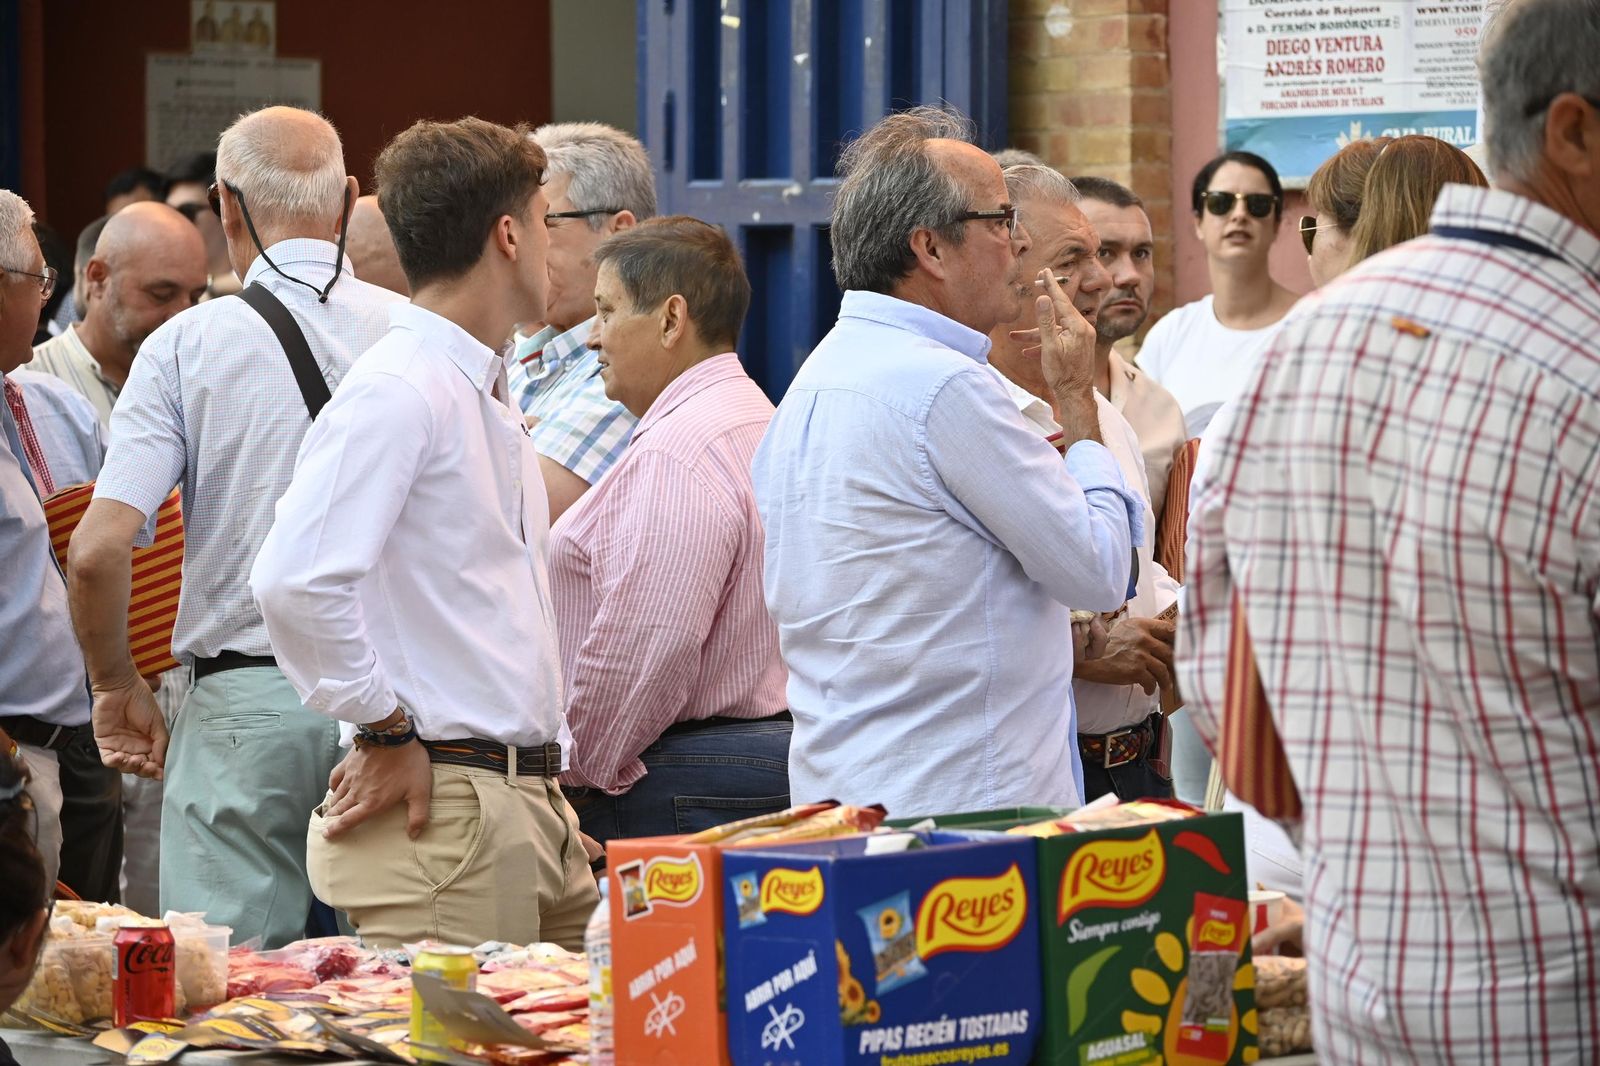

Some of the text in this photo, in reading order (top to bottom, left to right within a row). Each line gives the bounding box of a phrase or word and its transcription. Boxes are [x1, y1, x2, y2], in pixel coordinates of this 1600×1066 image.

[1264, 6, 1381, 18] Corrida de Rejones
[1266, 35, 1383, 56] DIEGO VENTURA
[1264, 56, 1385, 77] ANDRÉS ROMERO
[648, 867, 694, 896] Reyes
[1071, 848, 1154, 899] Reyes
[765, 875, 816, 906] Reyes
[925, 888, 1014, 943] Reyes
[1067, 910, 1161, 944] Siempre contigo
[653, 956, 675, 983] POR
[772, 968, 794, 996] POR
[859, 1009, 1029, 1055] PIPAS RECIÉN TOSTADAS
[1087, 1031, 1147, 1061] AGUASAL
